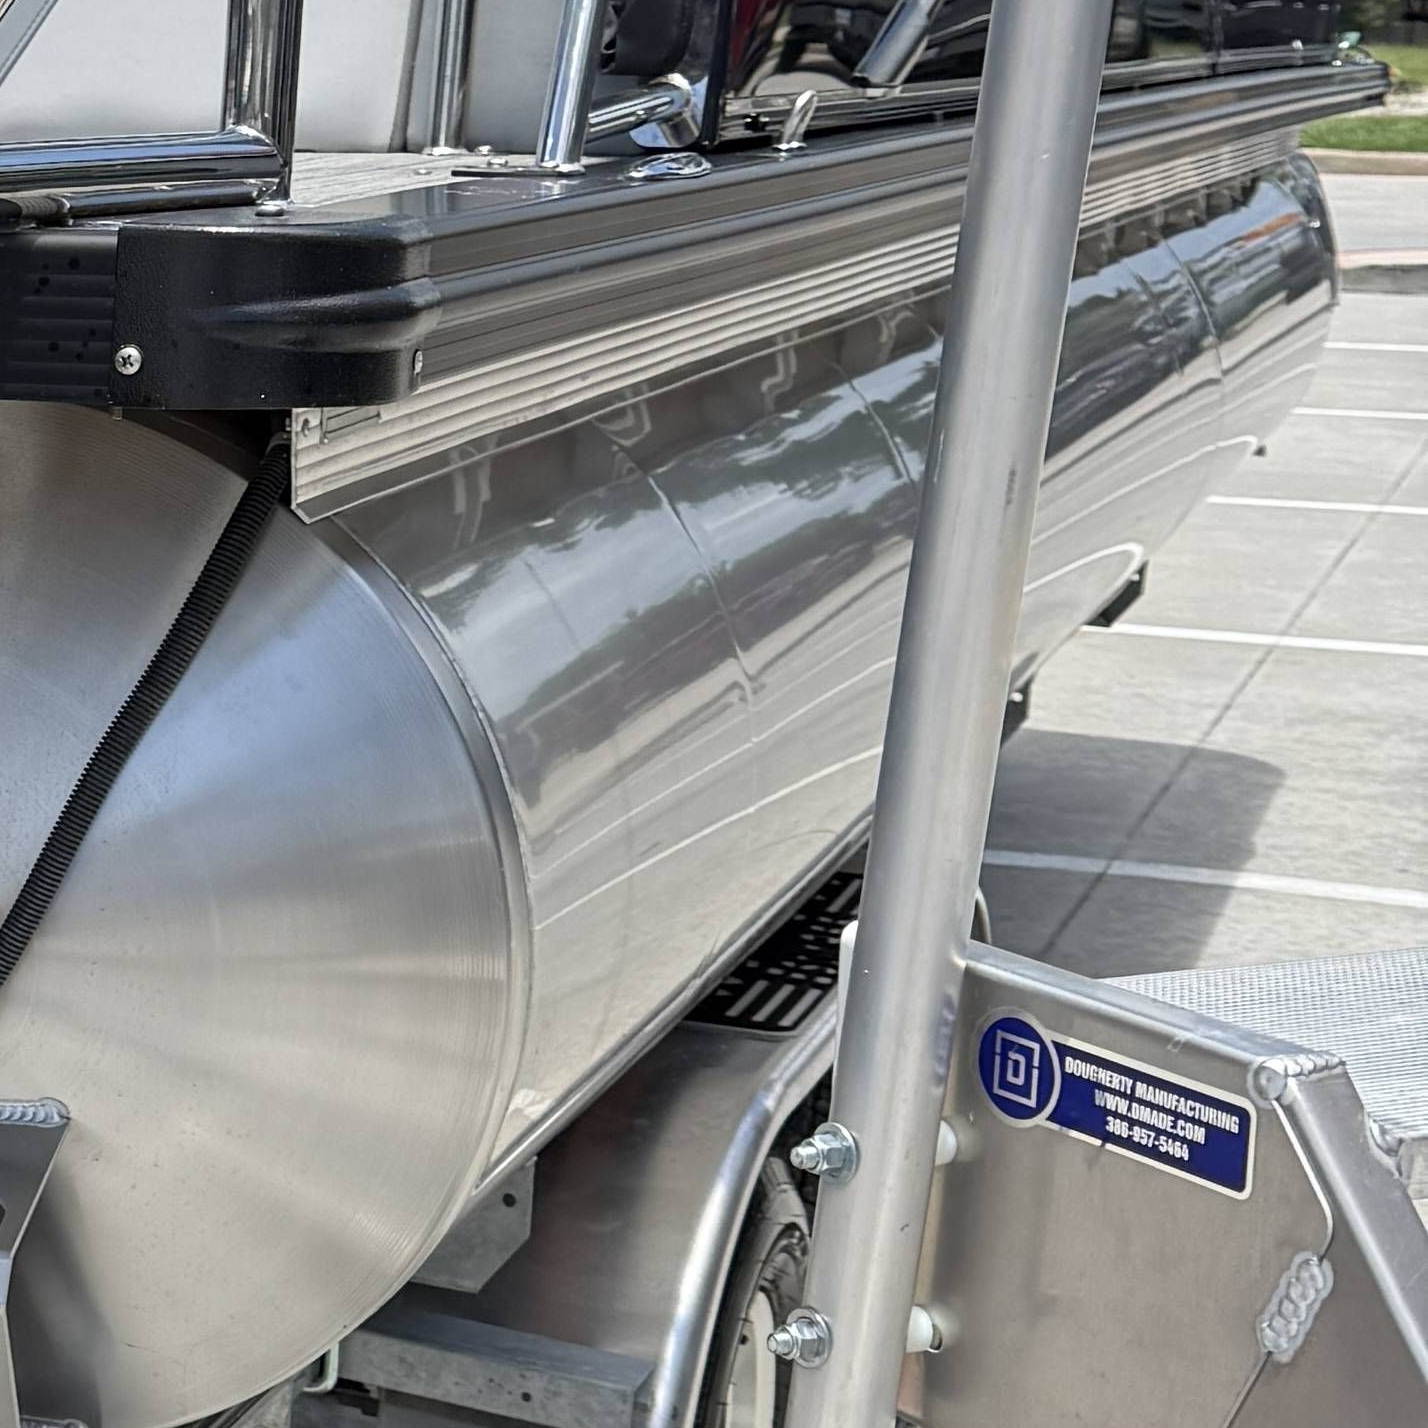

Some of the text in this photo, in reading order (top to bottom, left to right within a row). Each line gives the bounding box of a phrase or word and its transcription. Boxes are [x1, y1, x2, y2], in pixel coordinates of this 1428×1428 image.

[1064, 1056, 1240, 1134] DOUGHERTY MANUFACTURING
[1095, 1089, 1206, 1145] WWW.DMADE.COM
[1106, 1116, 1190, 1161] 386-957-5464
